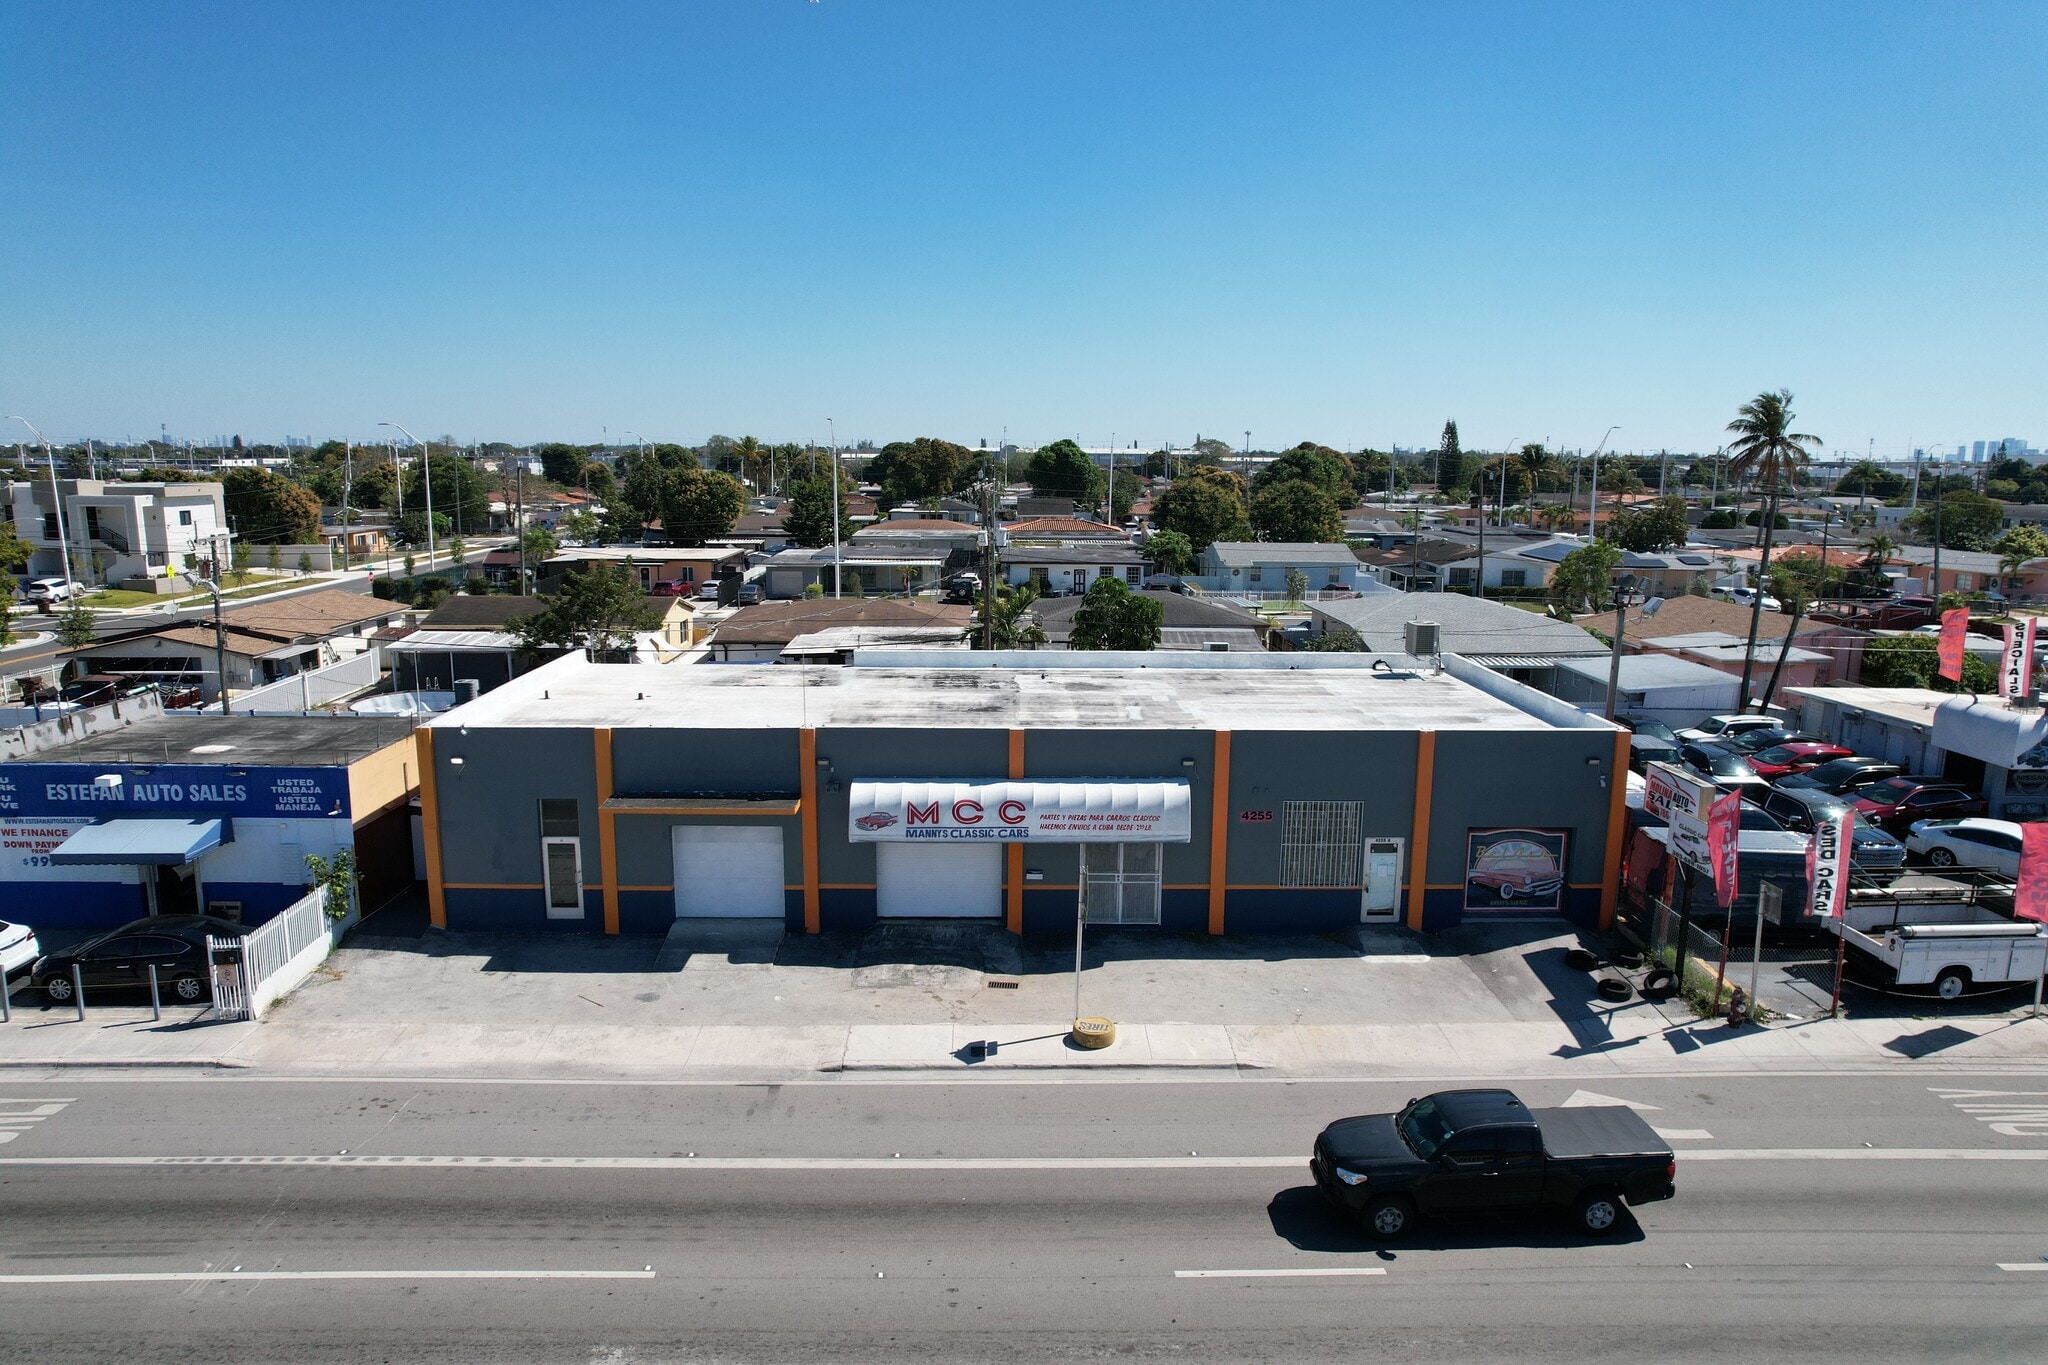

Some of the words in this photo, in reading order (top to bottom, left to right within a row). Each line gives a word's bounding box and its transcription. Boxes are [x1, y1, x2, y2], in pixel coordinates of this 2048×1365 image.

[46, 784, 125, 801] ESTEFAN
[133, 784, 184, 802] AUTO
[189, 784, 247, 802] SALES
[270, 786, 322, 794] TRABAJA
[1672, 792, 1690, 808] AUTO
[275, 803, 322, 811] MANEJA
[1241, 811, 1273, 821] 4255
[1, 828, 18, 837] WE
[21, 828, 69, 837] FINANCE
[950, 829, 994, 838] CLASSIC
[998, 829, 1029, 838] CARS
[4, 841, 33, 849] DOWN
[22, 856, 54, 867] $99
[1079, 1022, 1108, 1031] TIRES
